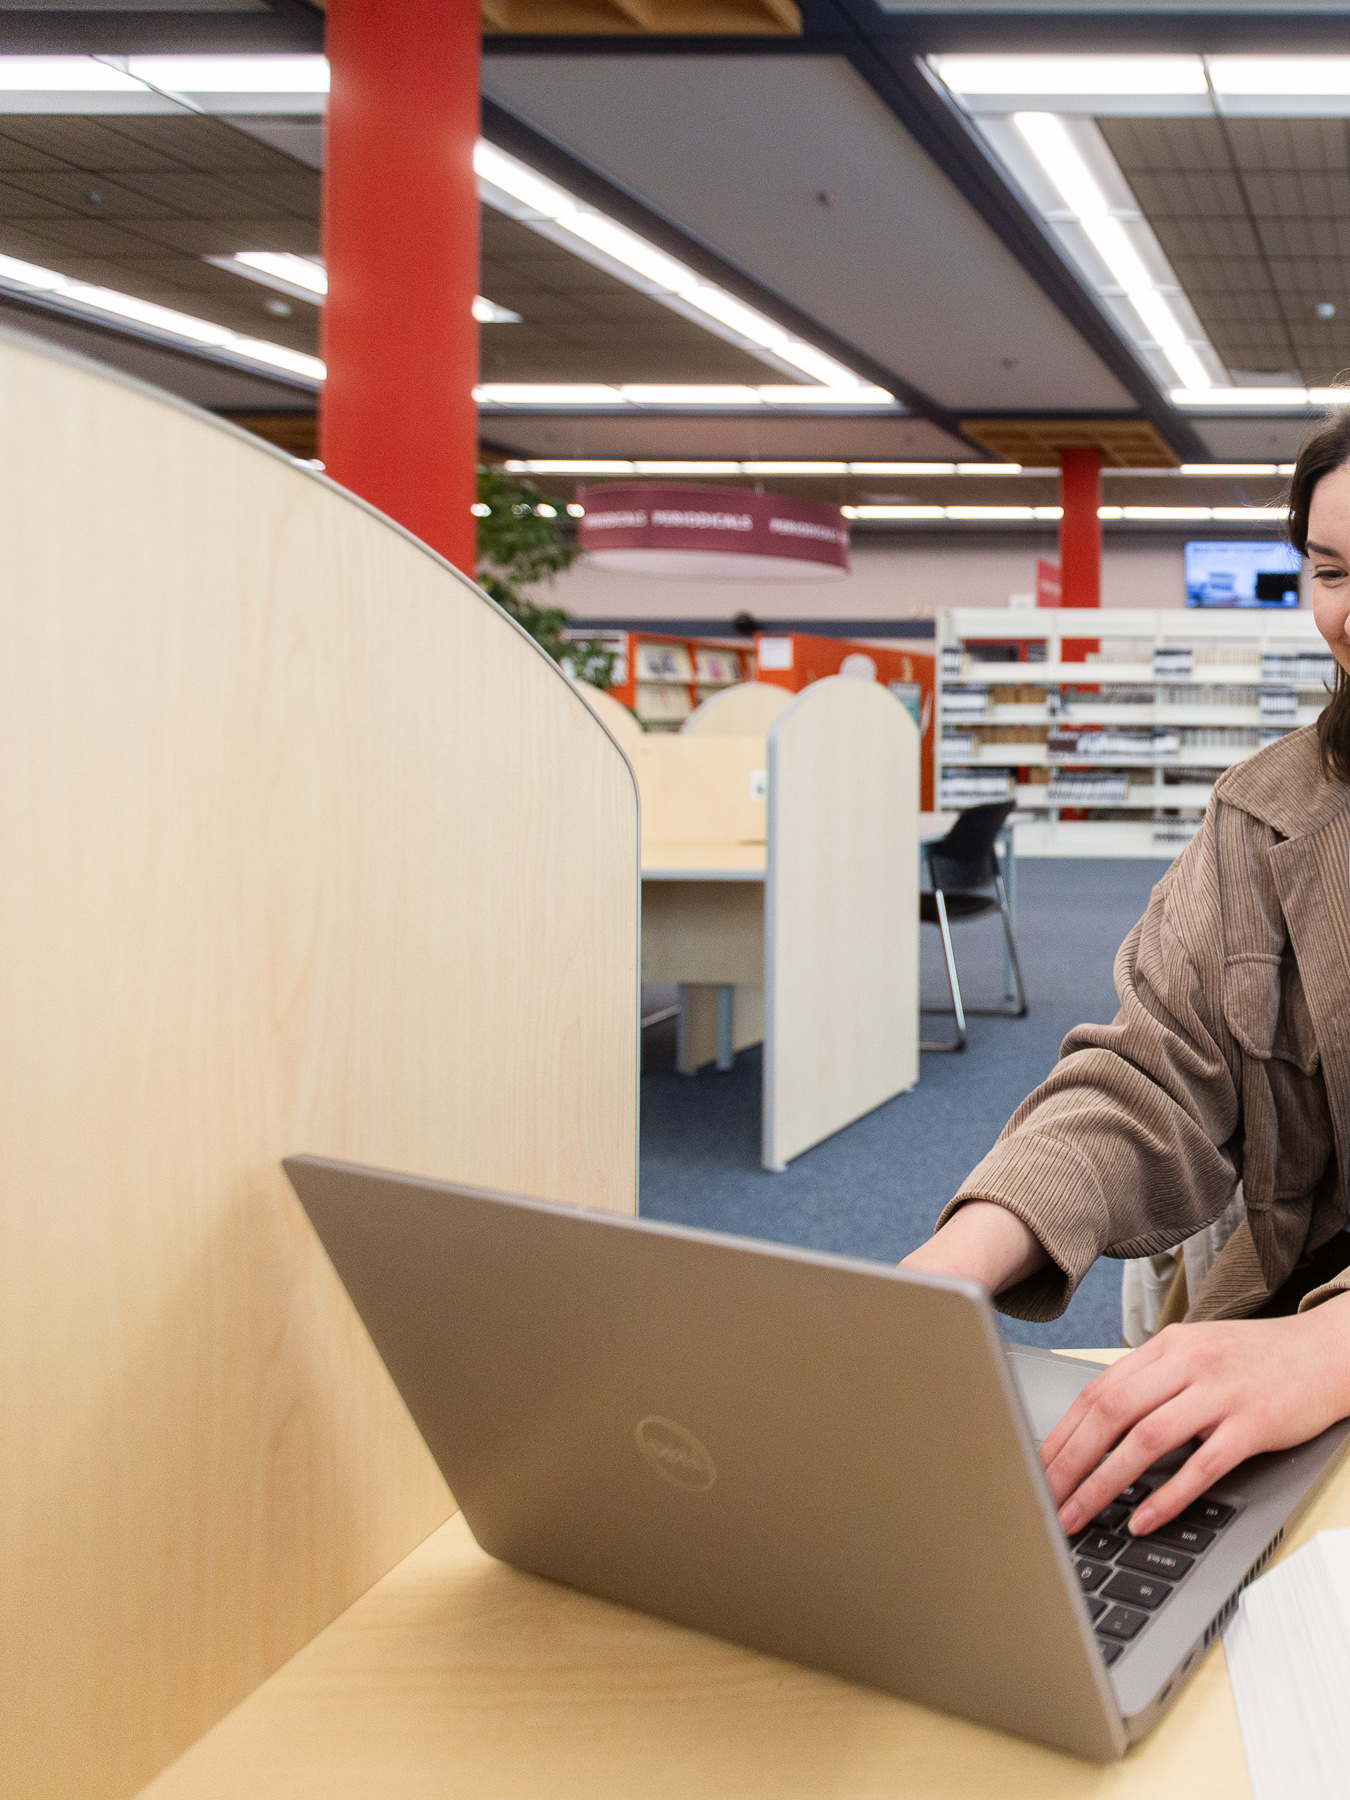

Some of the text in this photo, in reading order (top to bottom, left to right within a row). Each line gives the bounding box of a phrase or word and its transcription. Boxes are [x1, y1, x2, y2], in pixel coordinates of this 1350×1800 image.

[650, 509, 753, 531] PERIODICALS
[1098, 1537, 1108, 1549] A
[1081, 1565, 1093, 1579] Q
